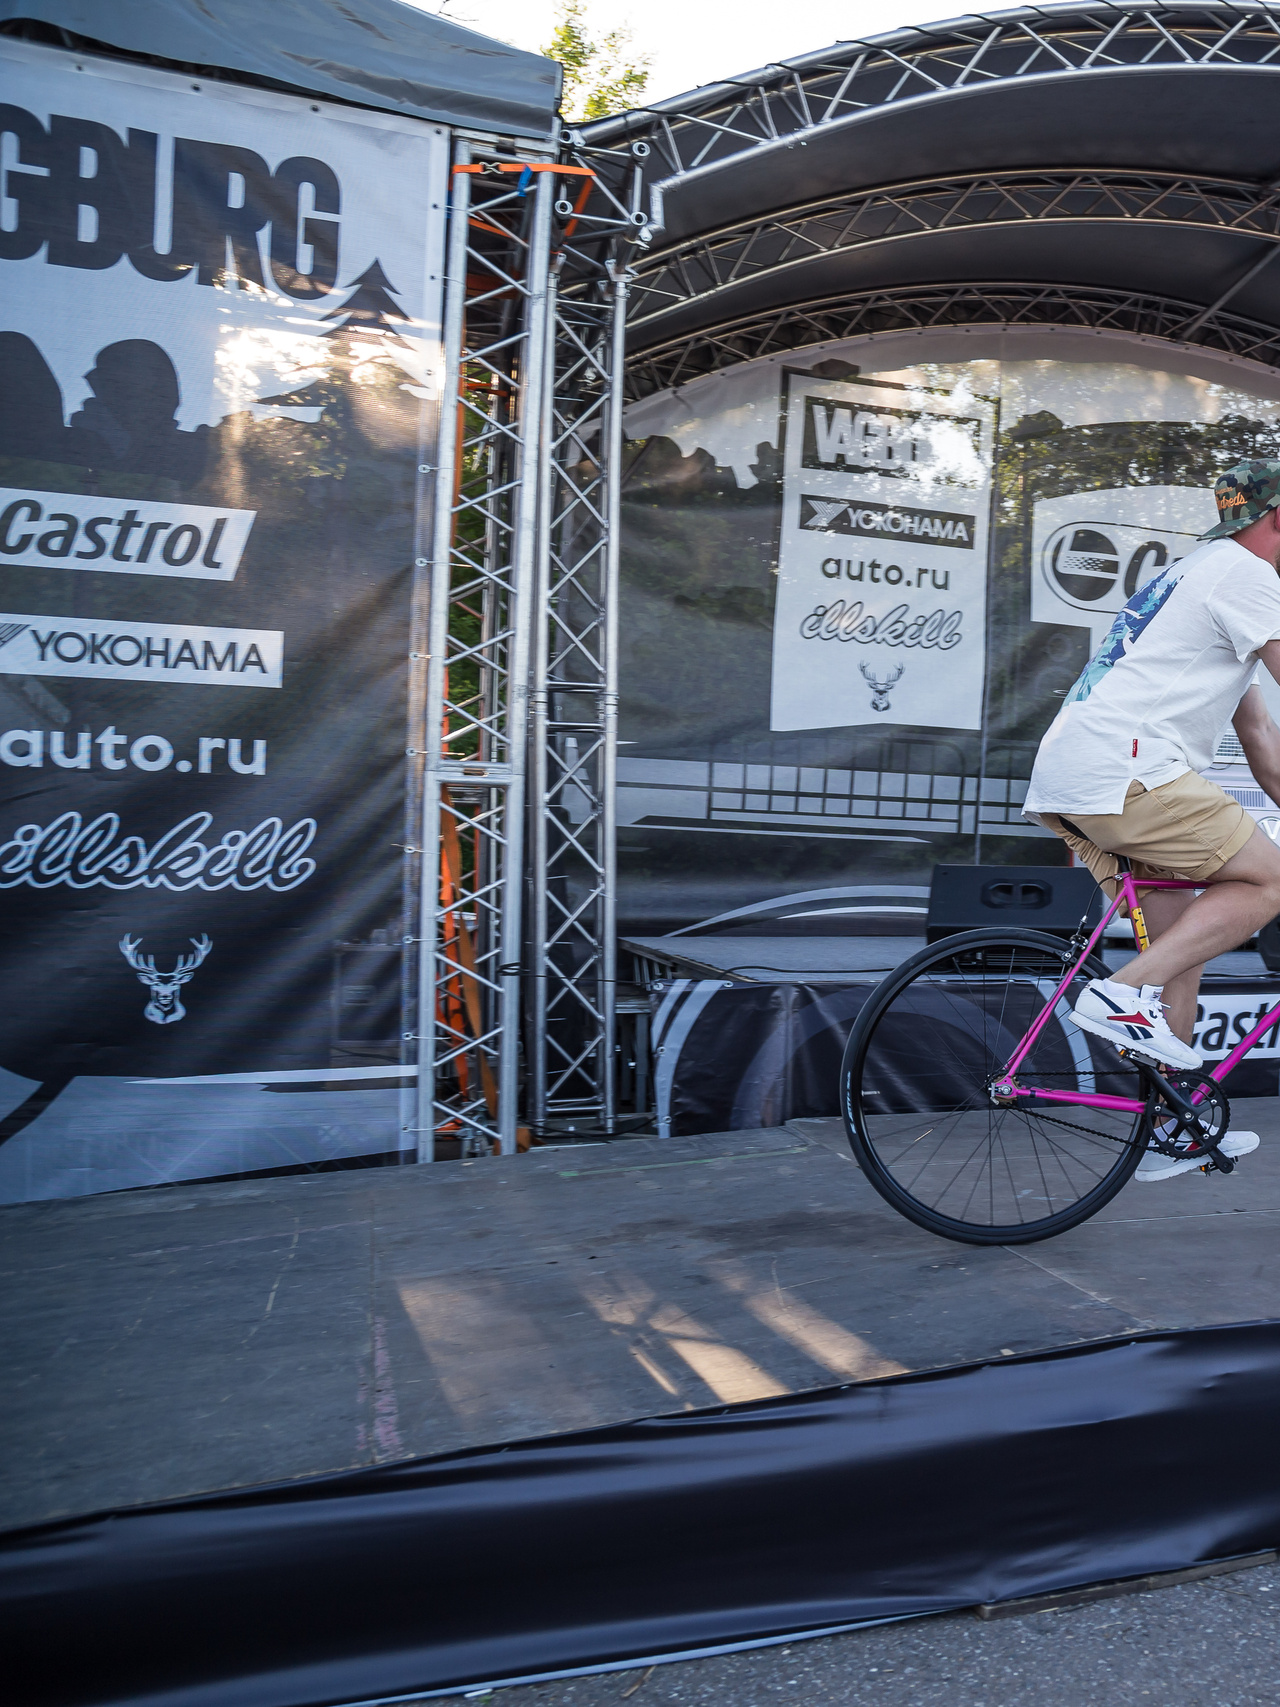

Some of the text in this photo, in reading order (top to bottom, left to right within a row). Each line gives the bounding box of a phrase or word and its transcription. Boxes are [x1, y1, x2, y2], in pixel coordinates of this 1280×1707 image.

[0, 103, 342, 300] GBURG
[0, 498, 230, 569] Castrol
[847, 506, 970, 541] YOKOHAMA
[821, 557, 950, 590] auto.ru
[800, 599, 963, 650] illskill
[30, 628, 268, 674] YOKOHAMA
[0, 725, 268, 776] auto.ru
[0, 811, 318, 892] illskill
